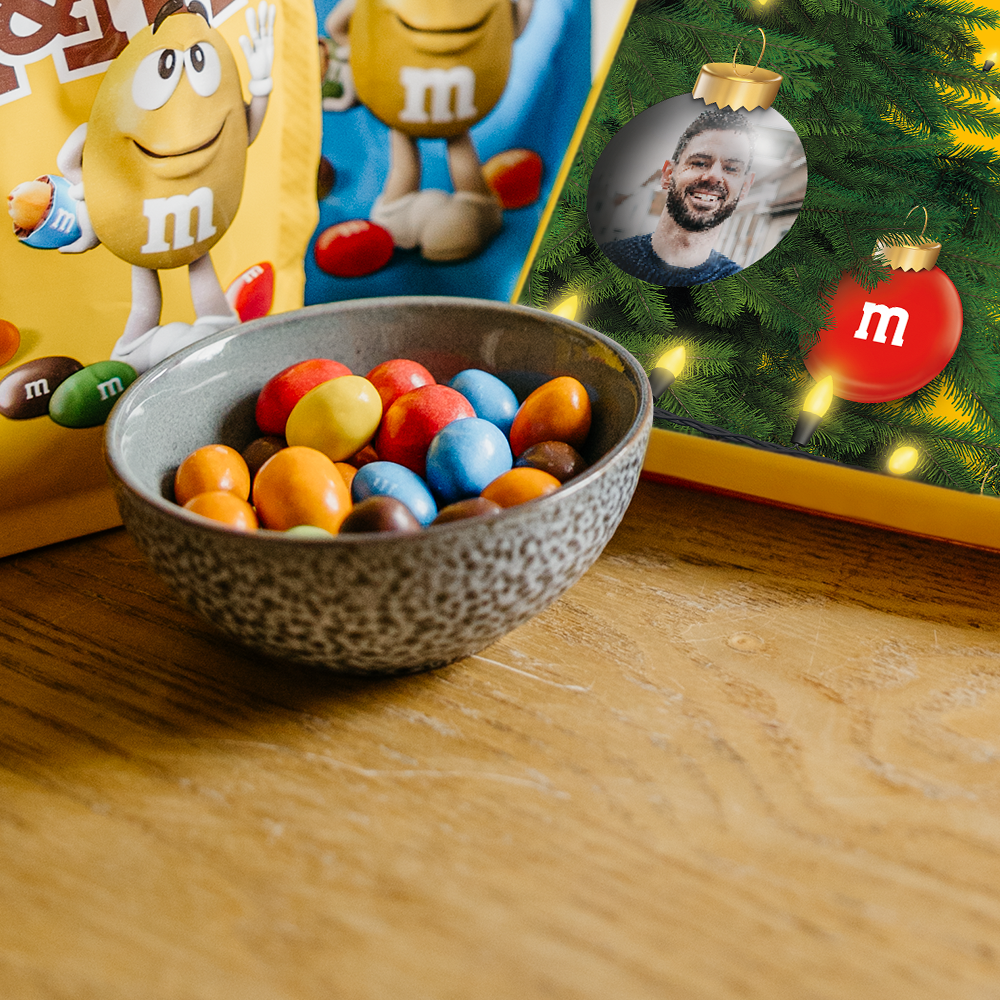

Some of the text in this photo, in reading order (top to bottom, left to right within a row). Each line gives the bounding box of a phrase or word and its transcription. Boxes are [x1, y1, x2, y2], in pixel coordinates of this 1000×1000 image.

[401, 66, 477, 123] m
[141, 186, 217, 254] m
[854, 301, 910, 348] m
[25, 378, 50, 400] m
[97, 376, 124, 400] m
